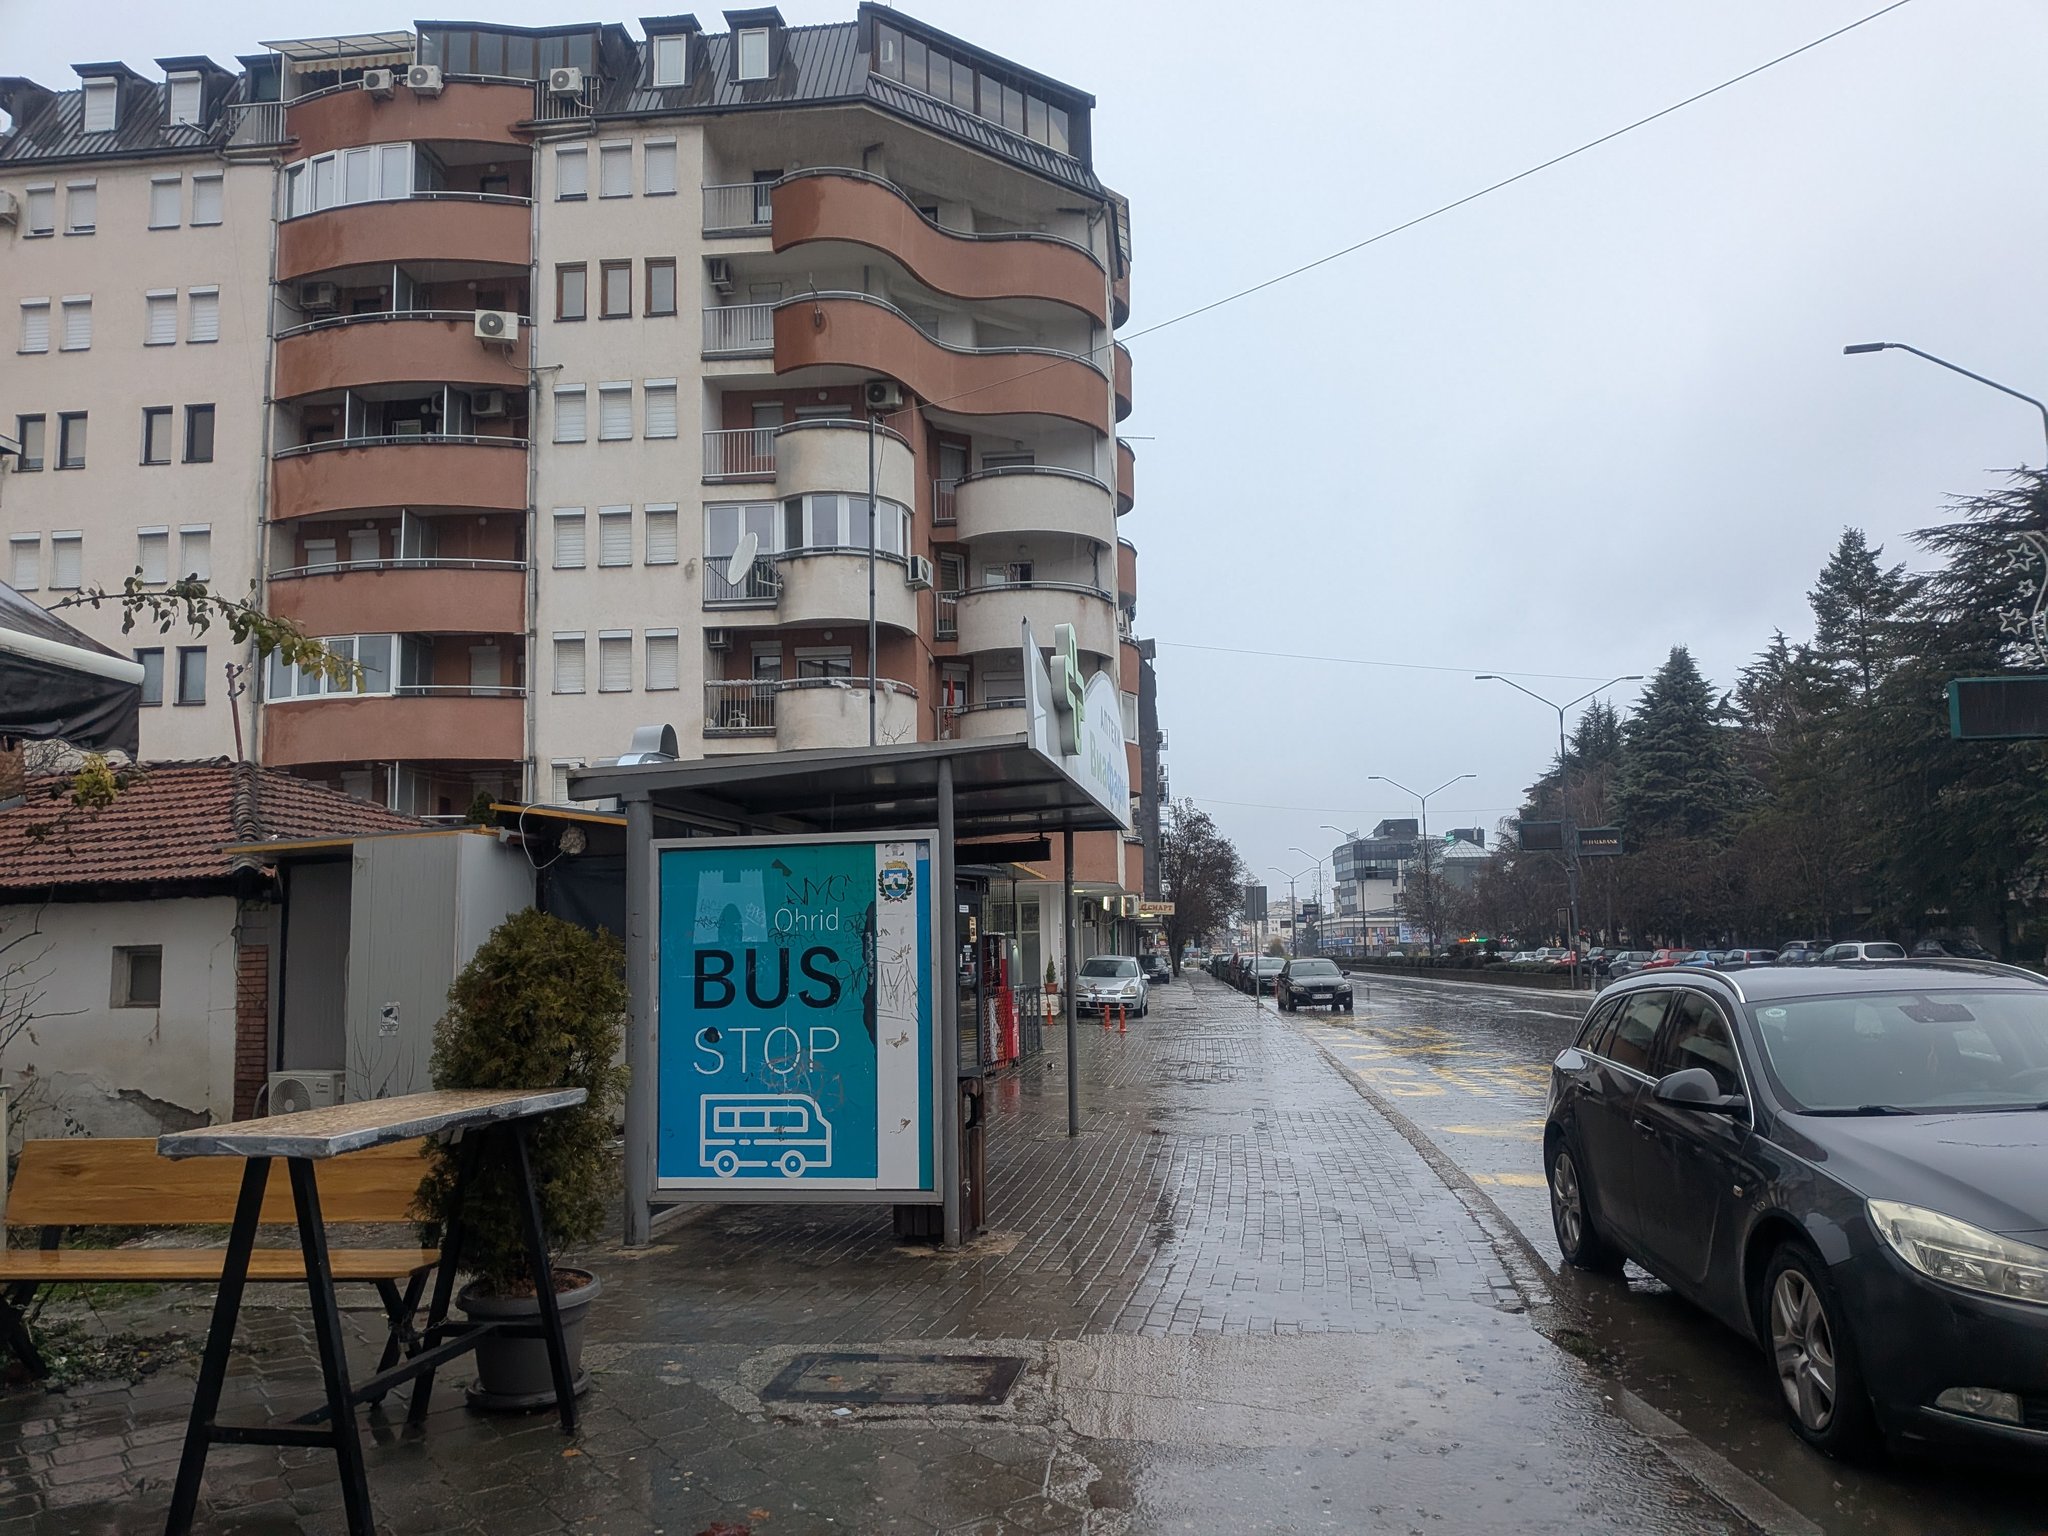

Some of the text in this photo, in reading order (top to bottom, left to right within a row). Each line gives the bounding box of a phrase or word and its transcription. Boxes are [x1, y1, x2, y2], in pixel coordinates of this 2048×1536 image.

[774, 907, 839, 932] Ohrid
[693, 946, 841, 1010] BUS
[693, 1026, 840, 1075] STOP
